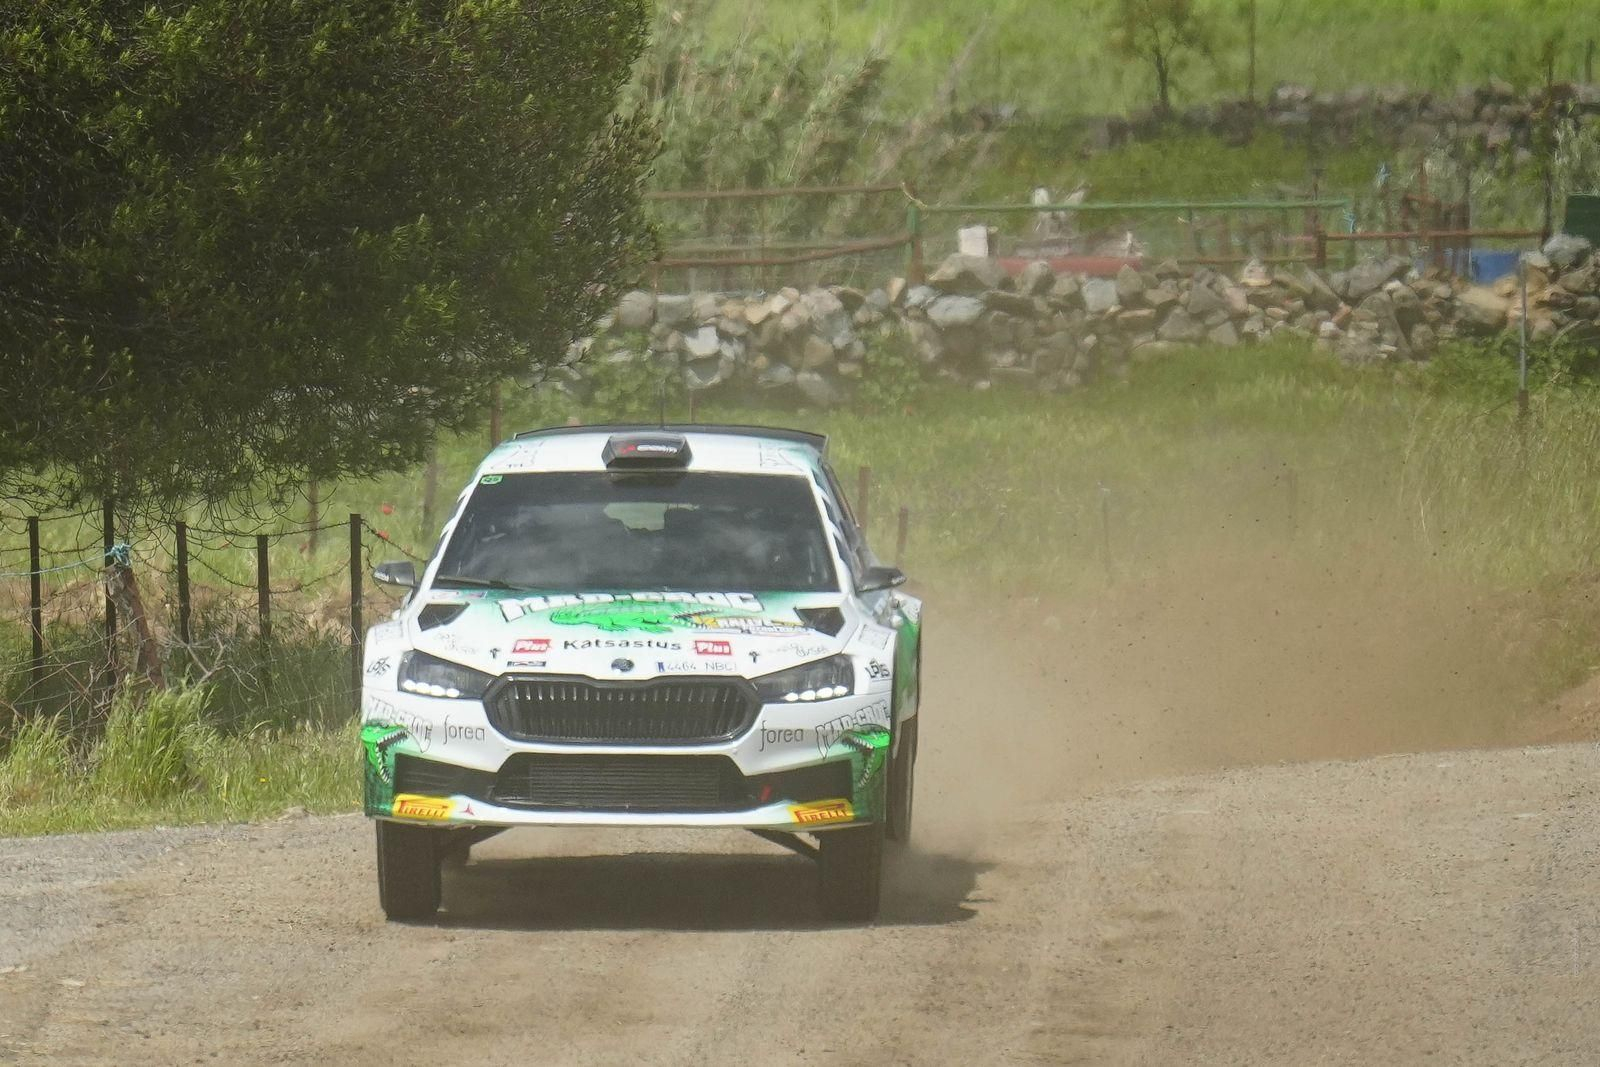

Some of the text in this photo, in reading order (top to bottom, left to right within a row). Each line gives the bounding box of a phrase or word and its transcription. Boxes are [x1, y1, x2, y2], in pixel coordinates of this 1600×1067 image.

[563, 638, 682, 651] Katsastus
[759, 719, 804, 752] forea
[398, 799, 448, 818] PIRELLI
[794, 802, 848, 824] PIRELLI
